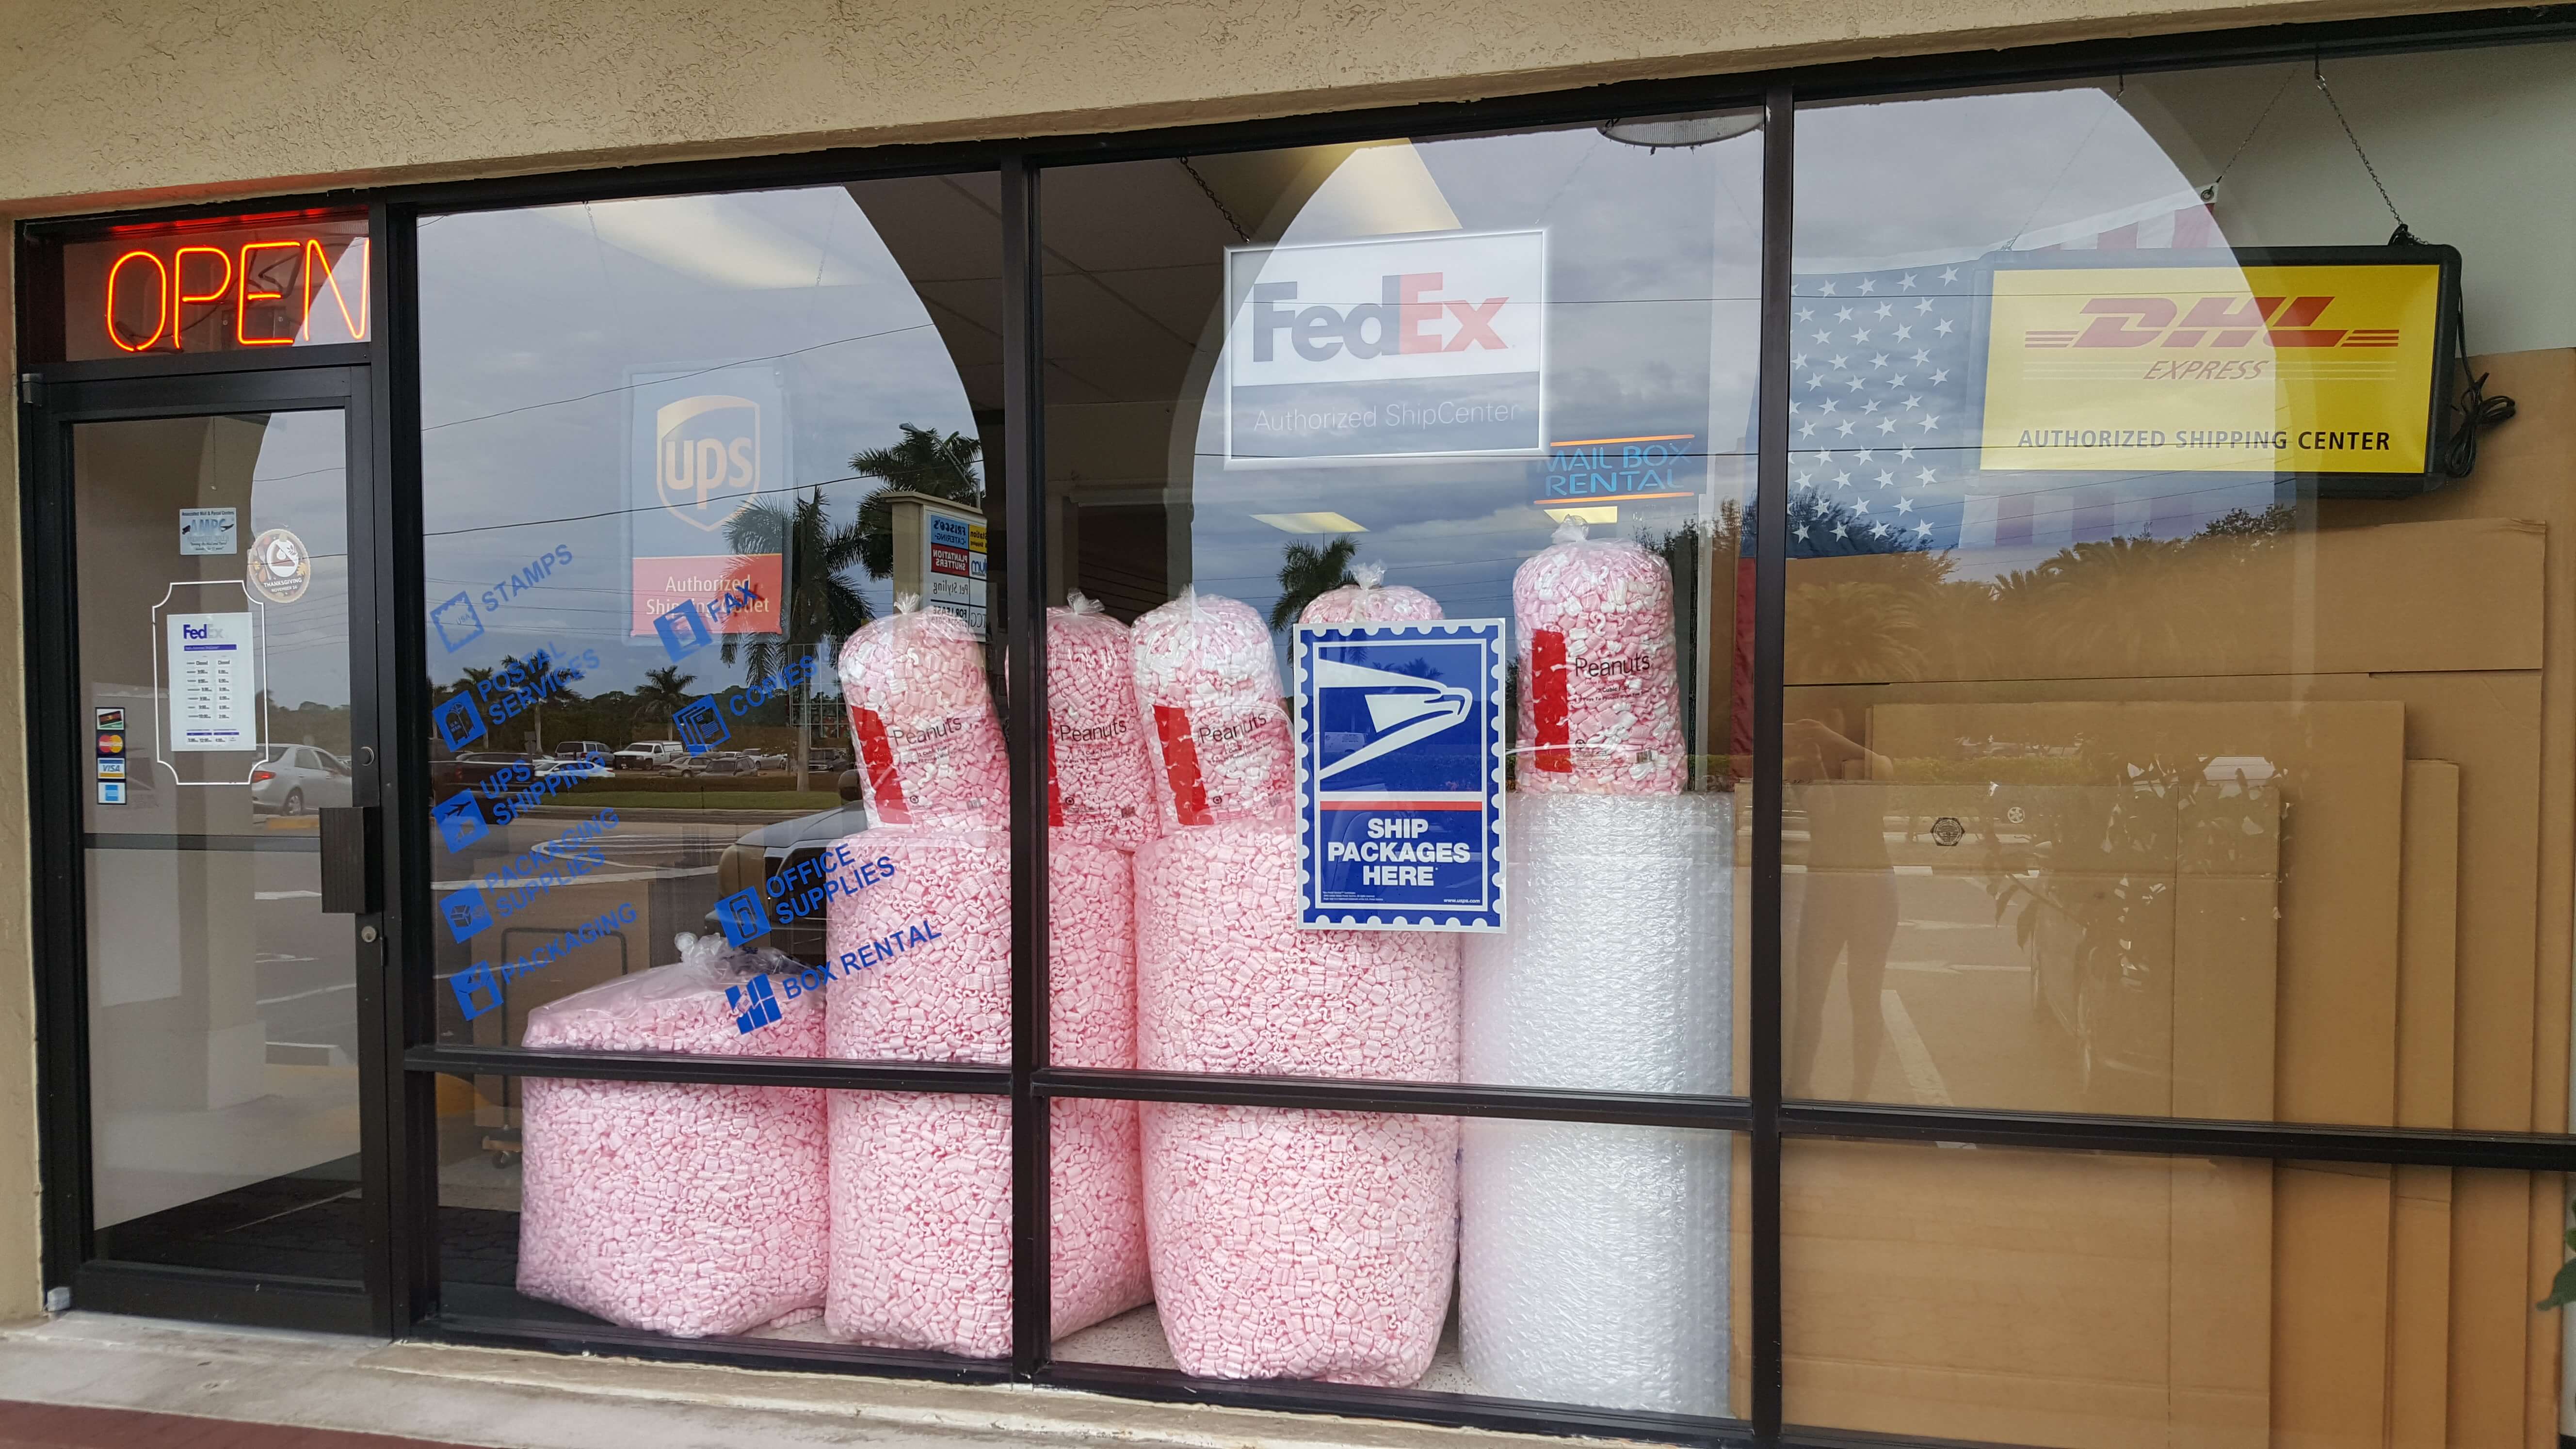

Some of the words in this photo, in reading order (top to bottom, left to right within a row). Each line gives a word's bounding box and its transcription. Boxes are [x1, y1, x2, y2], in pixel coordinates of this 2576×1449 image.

[106, 238, 370, 353] OPEN
[1253, 272, 1510, 362] FedEx
[2073, 296, 2348, 348] DHL
[2142, 360, 2270, 381] EXPRESS
[1254, 405, 1377, 433] Authorized
[1385, 401, 1518, 430] ShipCenter
[1536, 447, 1613, 473] MAIL
[1623, 442, 1692, 468] BOX
[2017, 429, 2166, 449] AUTHORIZED
[2175, 430, 2287, 450] SHIPPING
[2298, 431, 2390, 451] CENTER
[1545, 468, 1684, 497] RENTAL
[263, 577, 302, 587] THANKSGIVING
[482, 544, 573, 612] STAMPS
[665, 574, 751, 592] Authorized
[706, 580, 758, 623] FAX
[183, 624, 224, 639] FedEx
[477, 641, 566, 702] POSTAL
[1575, 653, 1650, 677] Peanuts
[489, 648, 600, 725] SERVICES
[729, 655, 818, 716] COPIES
[893, 717, 962, 746] Peanuts
[1060, 719, 1127, 742] Peanuts
[1199, 712, 1267, 743] Peanuts
[480, 759, 531, 799] UPS
[493, 751, 606, 825] SHIPPING
[1368, 818, 1428, 839] SHIP
[485, 807, 619, 896] PACKAGING
[766, 843, 856, 898] OFFICE
[1328, 842, 1470, 863] PACKAGES
[496, 846, 605, 917] SUPPLIES
[776, 855, 895, 924] SUPPLIES
[1363, 866, 1434, 886] HERE
[501, 902, 637, 984] PACKAGING
[782, 961, 838, 1000] BOX
[840, 920, 942, 975] RENTAL
